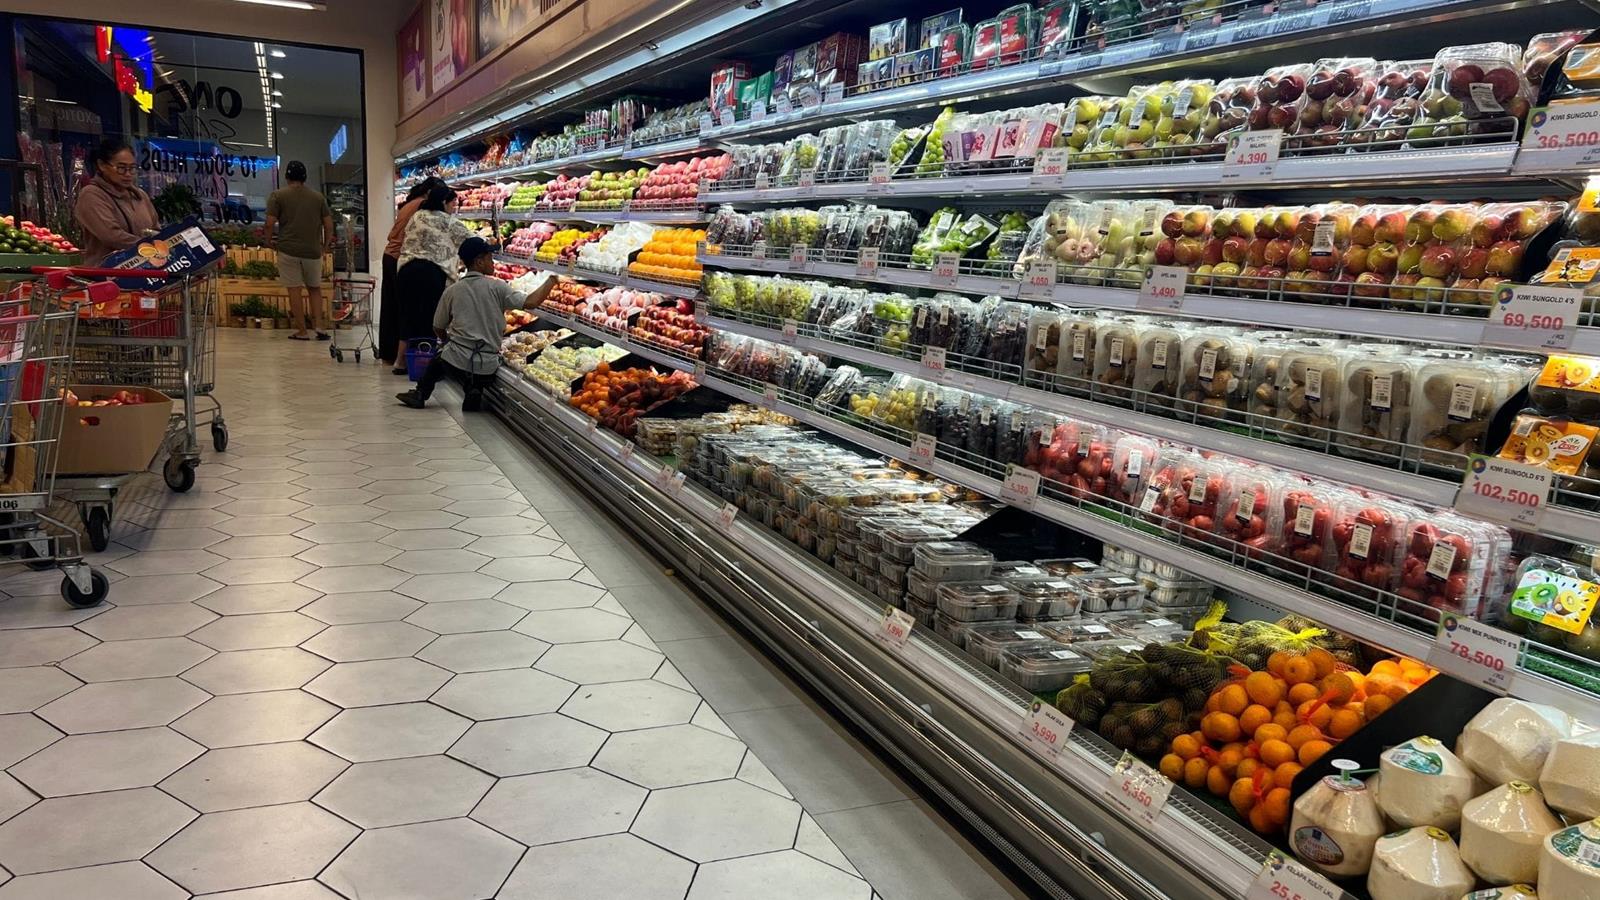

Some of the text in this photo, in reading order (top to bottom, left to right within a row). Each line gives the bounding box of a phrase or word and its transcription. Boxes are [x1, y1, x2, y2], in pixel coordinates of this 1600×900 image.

[1566, 110, 1598, 120] SUNGOLD
[120, 258, 140, 270] ORA
[146, 255, 192, 286] Sunt
[1152, 286, 1176, 298] 3,490
[1532, 295, 1564, 304] SUNGOLD
[1503, 312, 1564, 331] 69,500
[1489, 465, 1503, 473] KIWI
[1504, 468, 1534, 480] SUNGOLD
[1473, 481, 1540, 508] 102,500
[1458, 623, 1471, 633] KIWI
[1471, 628, 1481, 637] MIX
[1482, 632, 1508, 646] PUNNET
[1450, 640, 1505, 672] 78,500
[1032, 721, 1057, 744] 3,990
[1121, 780, 1152, 807] 5,350
[1270, 880, 1306, 900] 25,5
